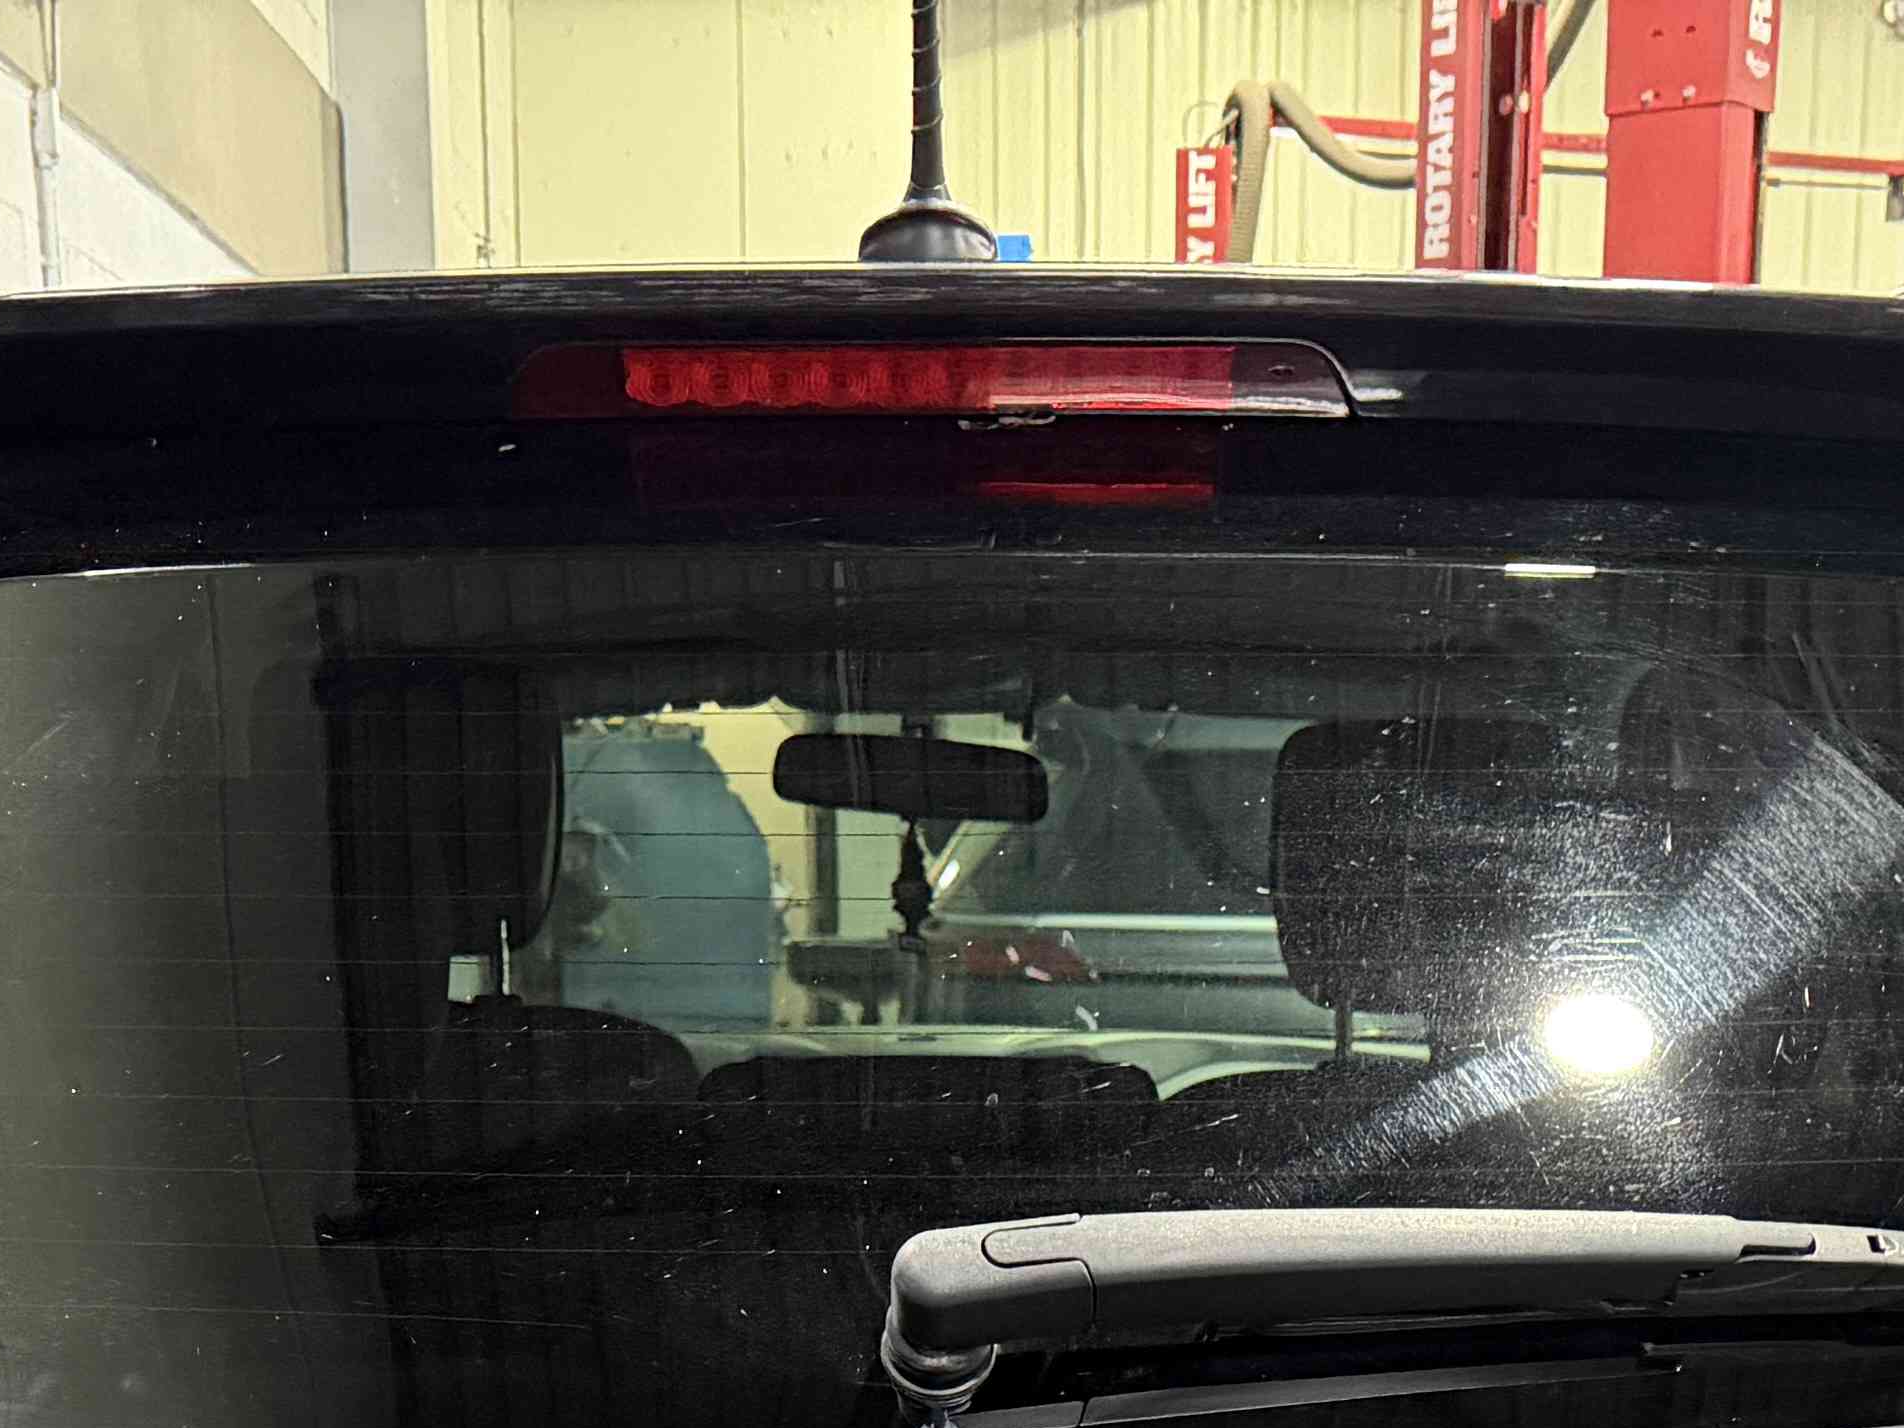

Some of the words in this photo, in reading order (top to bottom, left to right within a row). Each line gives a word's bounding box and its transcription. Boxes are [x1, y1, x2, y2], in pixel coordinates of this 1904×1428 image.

[1431, 0, 1458, 57] LI
[1187, 150, 1216, 228] LIFT
[1424, 69, 1457, 260] ROTARY
